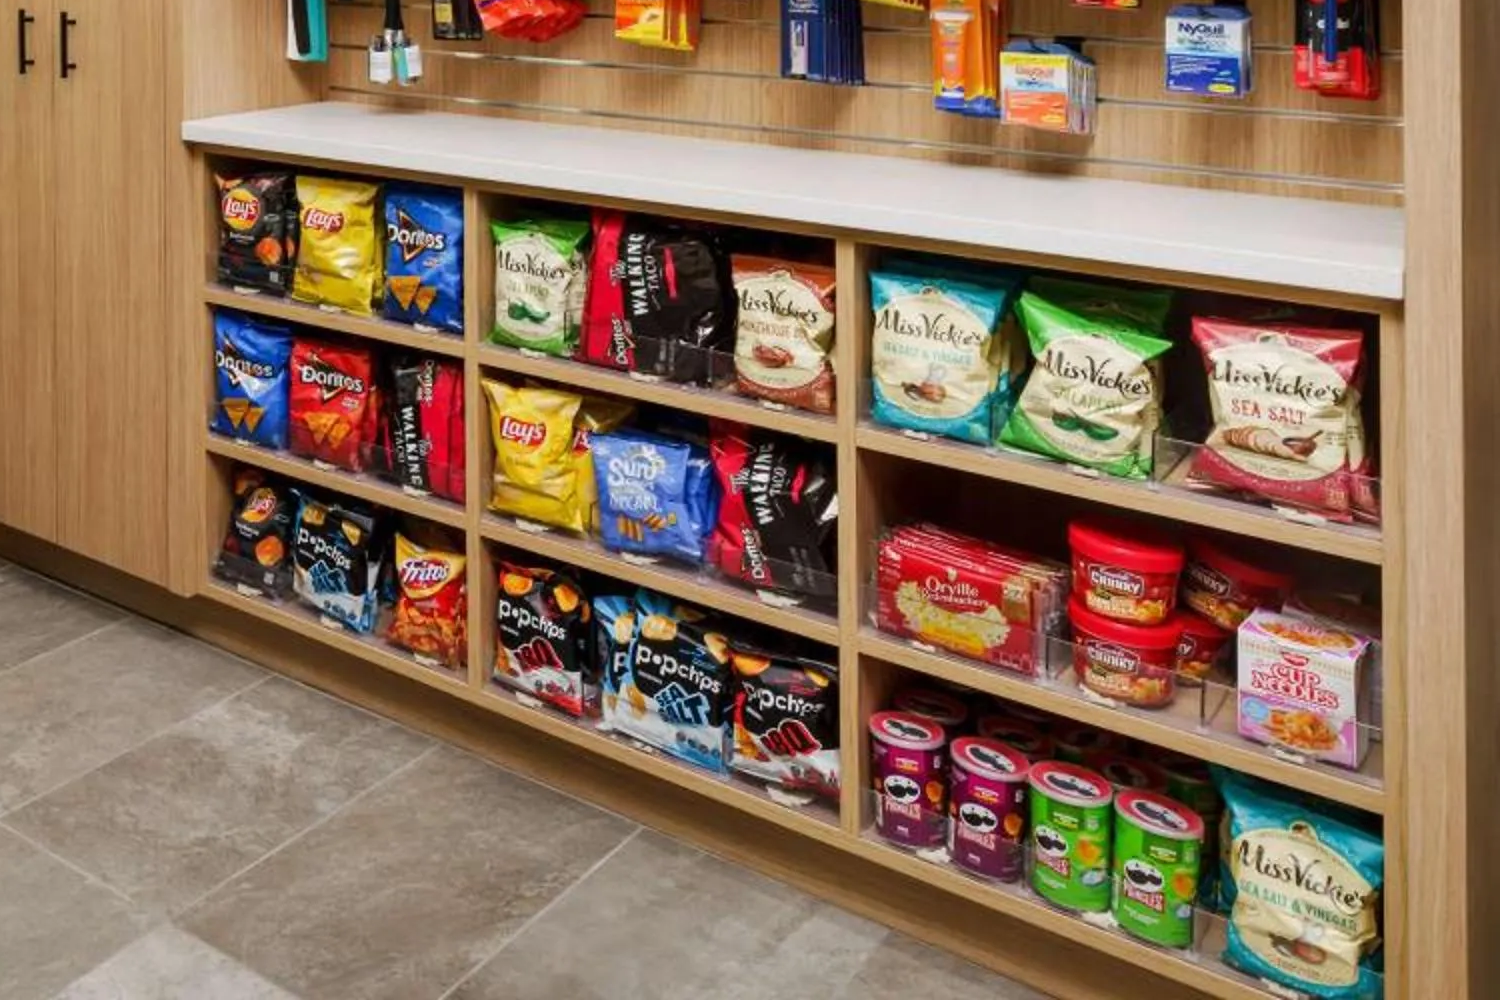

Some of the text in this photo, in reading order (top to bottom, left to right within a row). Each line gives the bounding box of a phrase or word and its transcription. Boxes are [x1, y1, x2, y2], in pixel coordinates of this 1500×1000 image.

[1178, 22, 1225, 36] NyQuil
[224, 202, 259, 219] Lay's
[304, 209, 343, 231] Lay's
[387, 223, 445, 250] Doritos
[214, 349, 274, 378] Doritos
[300, 364, 365, 393] Doritos
[1258, 364, 1342, 406] Vickie's
[1231, 398, 1307, 426] SEA SALT
[502, 416, 544, 445] Lay's
[400, 559, 451, 584] Fritos
[925, 576, 980, 598] Orville
[1270, 663, 1320, 688] CUP
[1251, 670, 1339, 710] NOODLES
[1239, 840, 1366, 913] Miss Vickie's
